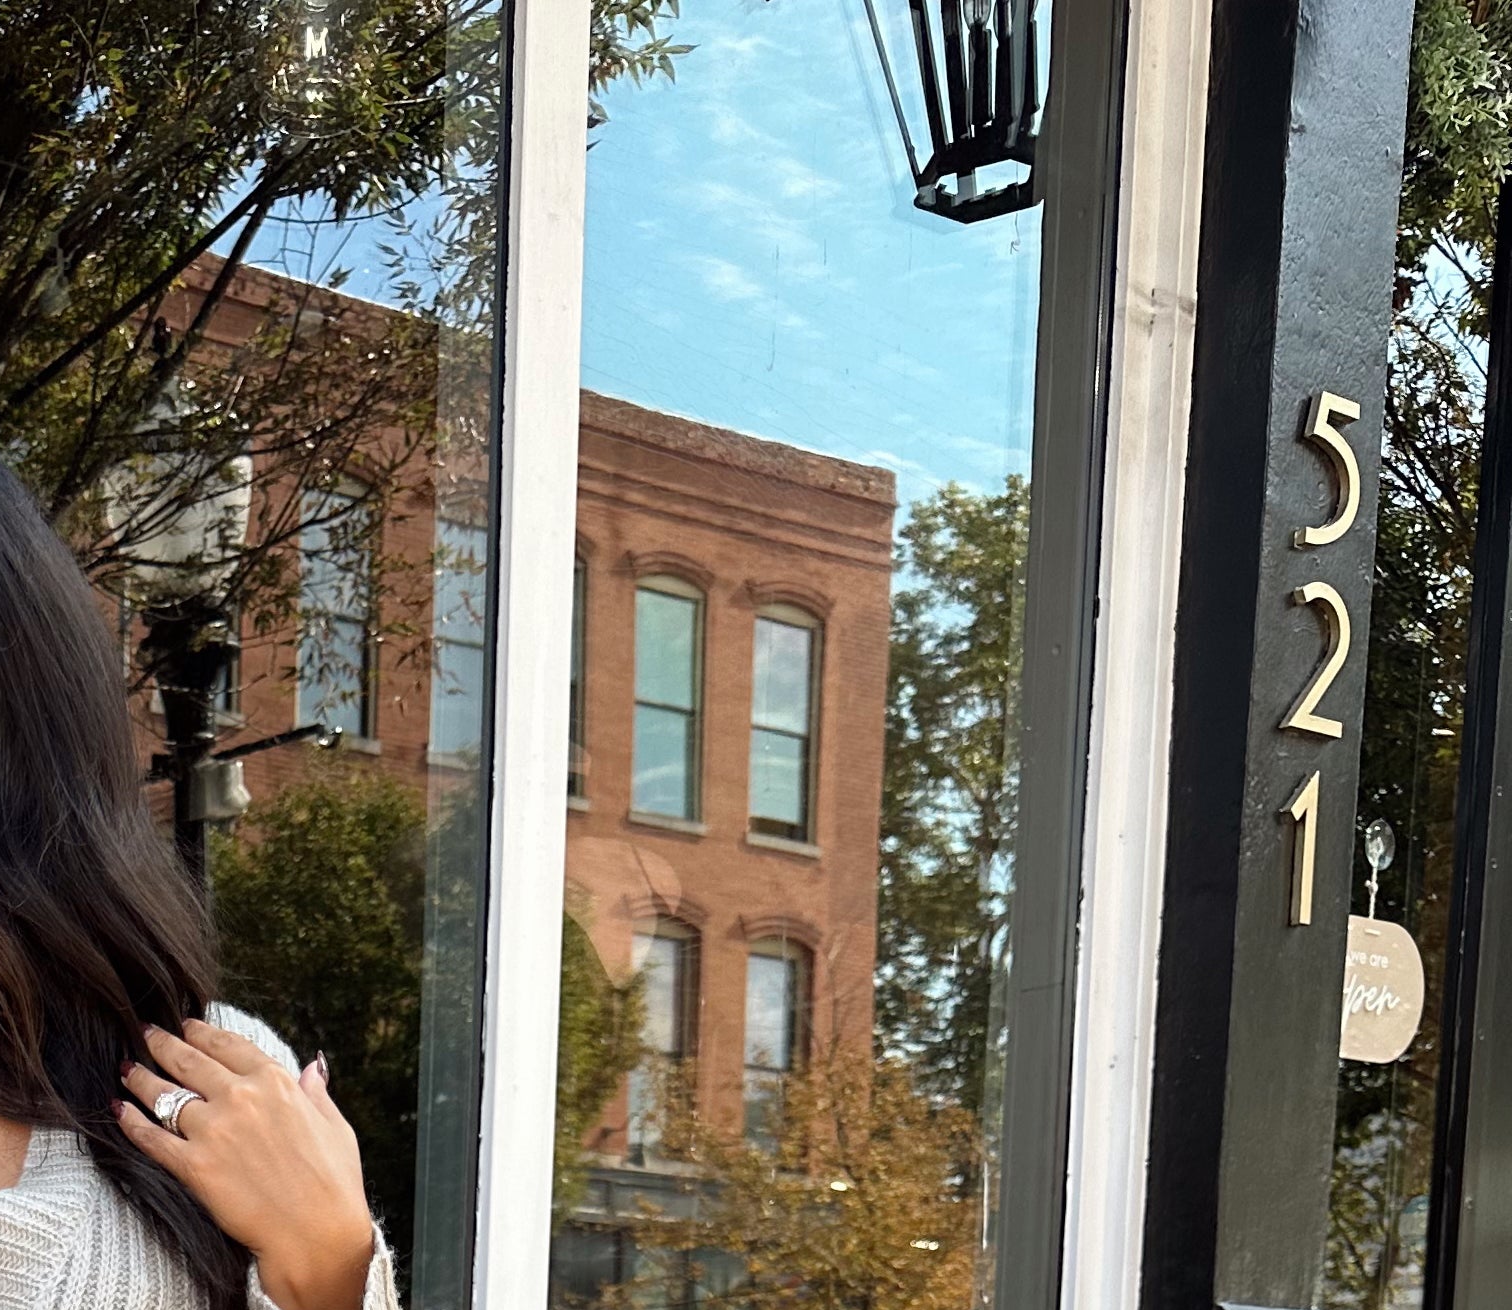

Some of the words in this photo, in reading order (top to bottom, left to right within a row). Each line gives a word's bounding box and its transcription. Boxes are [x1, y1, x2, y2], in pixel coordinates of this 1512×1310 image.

[1280, 390, 1361, 927] 521
[1369, 954, 1389, 968] are
[1342, 973, 1401, 1024] pen
